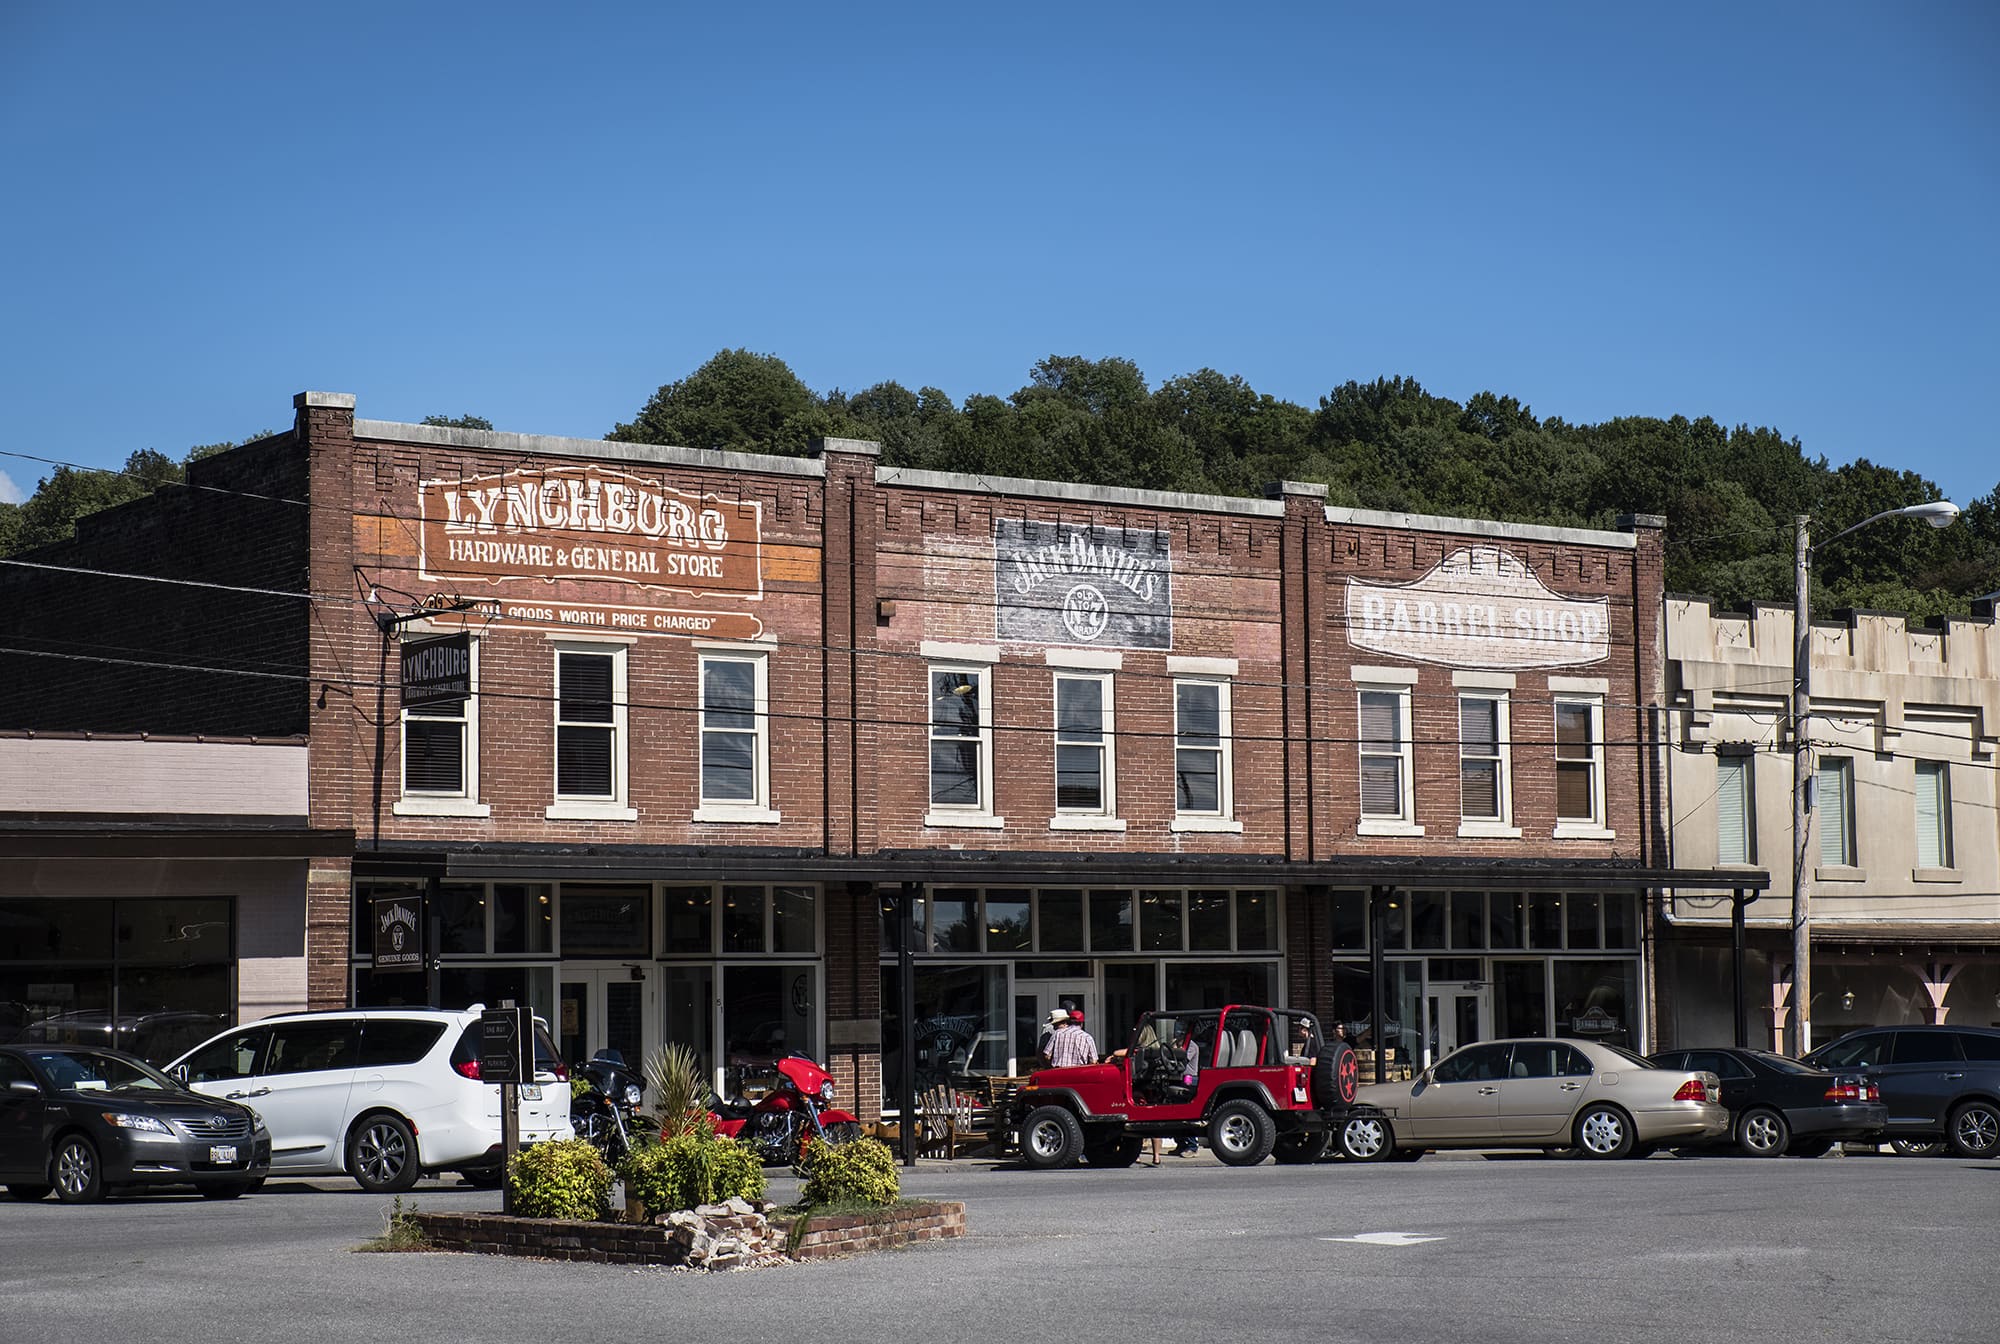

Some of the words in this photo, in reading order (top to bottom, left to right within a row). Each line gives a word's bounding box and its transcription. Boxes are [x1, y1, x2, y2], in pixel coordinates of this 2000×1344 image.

[444, 478, 728, 550] LYNCHBURG
[448, 539, 553, 567] HARDWARE
[556, 548, 569, 566] &
[571, 547, 659, 574] GENERAL
[667, 553, 723, 578] STORE
[508, 606, 553, 621] GOODS
[559, 609, 605, 626] WORTH
[612, 612, 647, 628] PRICE
[1361, 593, 1501, 642] BARREL
[1514, 604, 1599, 653] SHOP
[402, 646, 467, 684] LYNCHBURG
